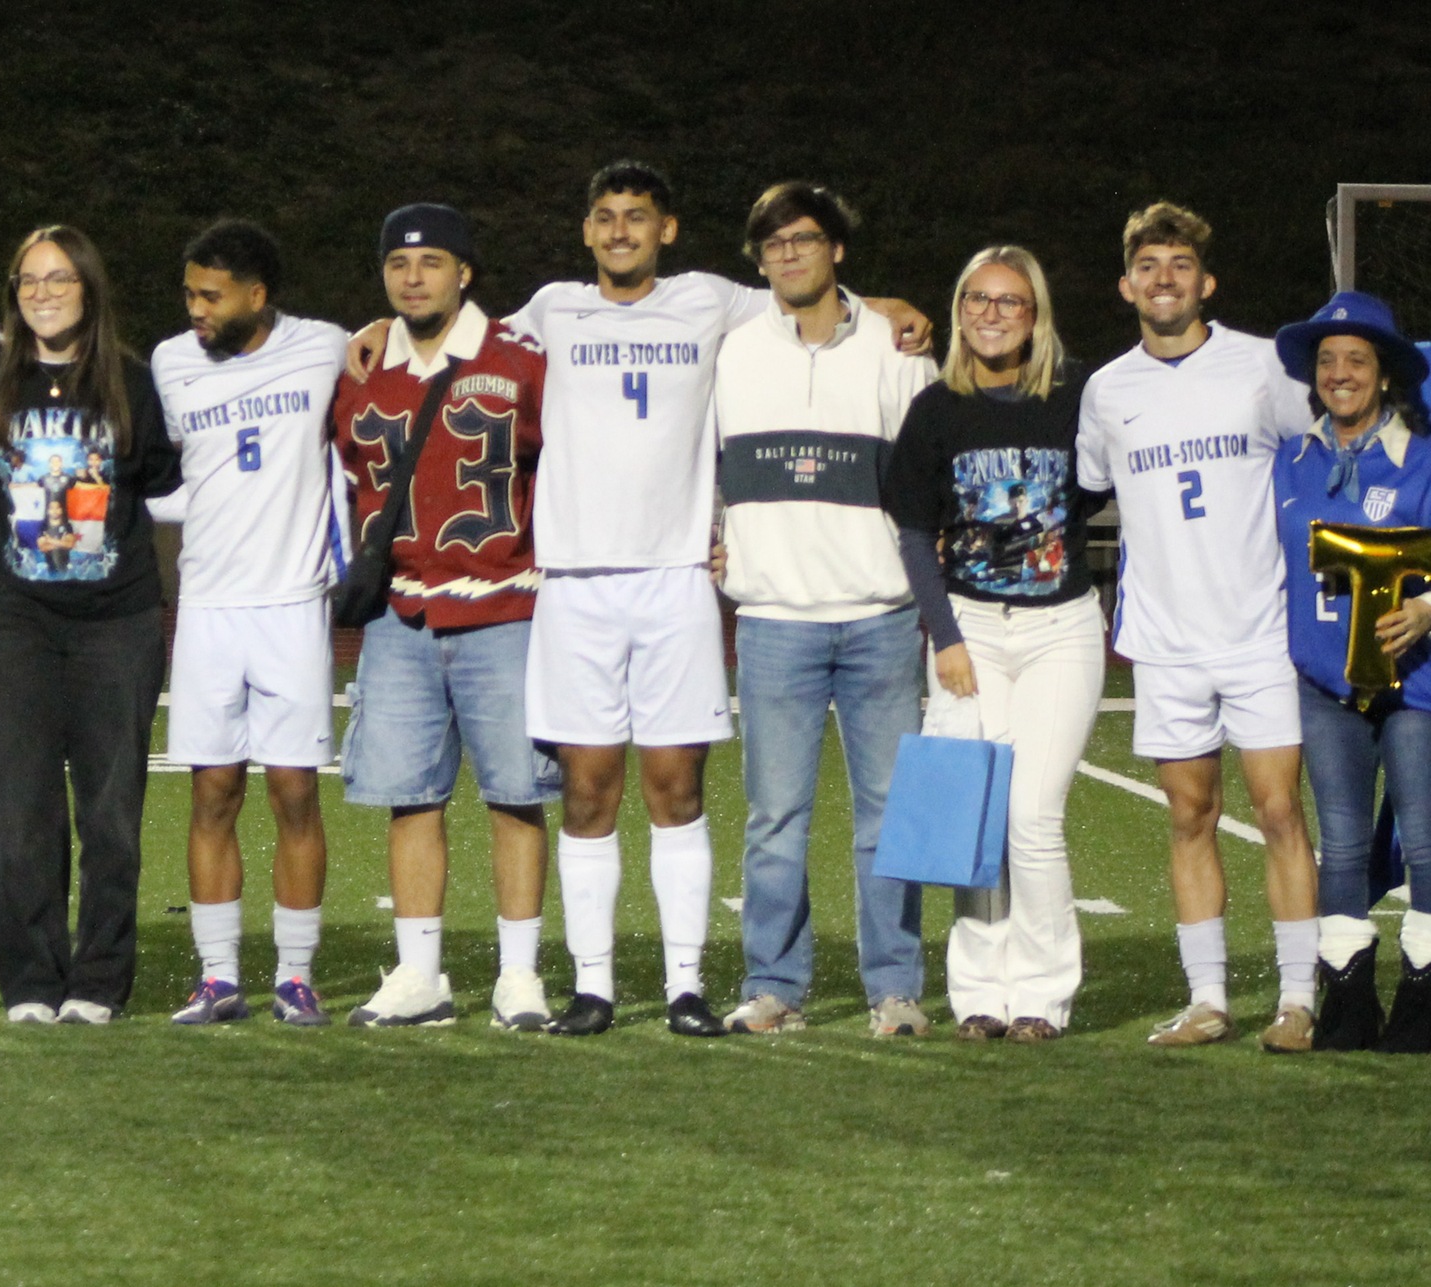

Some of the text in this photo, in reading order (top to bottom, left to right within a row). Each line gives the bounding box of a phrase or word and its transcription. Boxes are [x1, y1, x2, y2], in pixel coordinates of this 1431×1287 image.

[571, 342, 699, 366] CULVER-STOCKTON
[453, 375, 517, 402] TRIUMPH
[622, 371, 648, 420] 4
[182, 390, 310, 434] CULVER-STOCKTON
[236, 426, 262, 472] 6
[755, 446, 857, 463] SALT LAKE CITY
[1128, 433, 1248, 474] CULVER-STOCKTON
[794, 473, 815, 484] UTAH
[1177, 470, 1206, 520] 2
